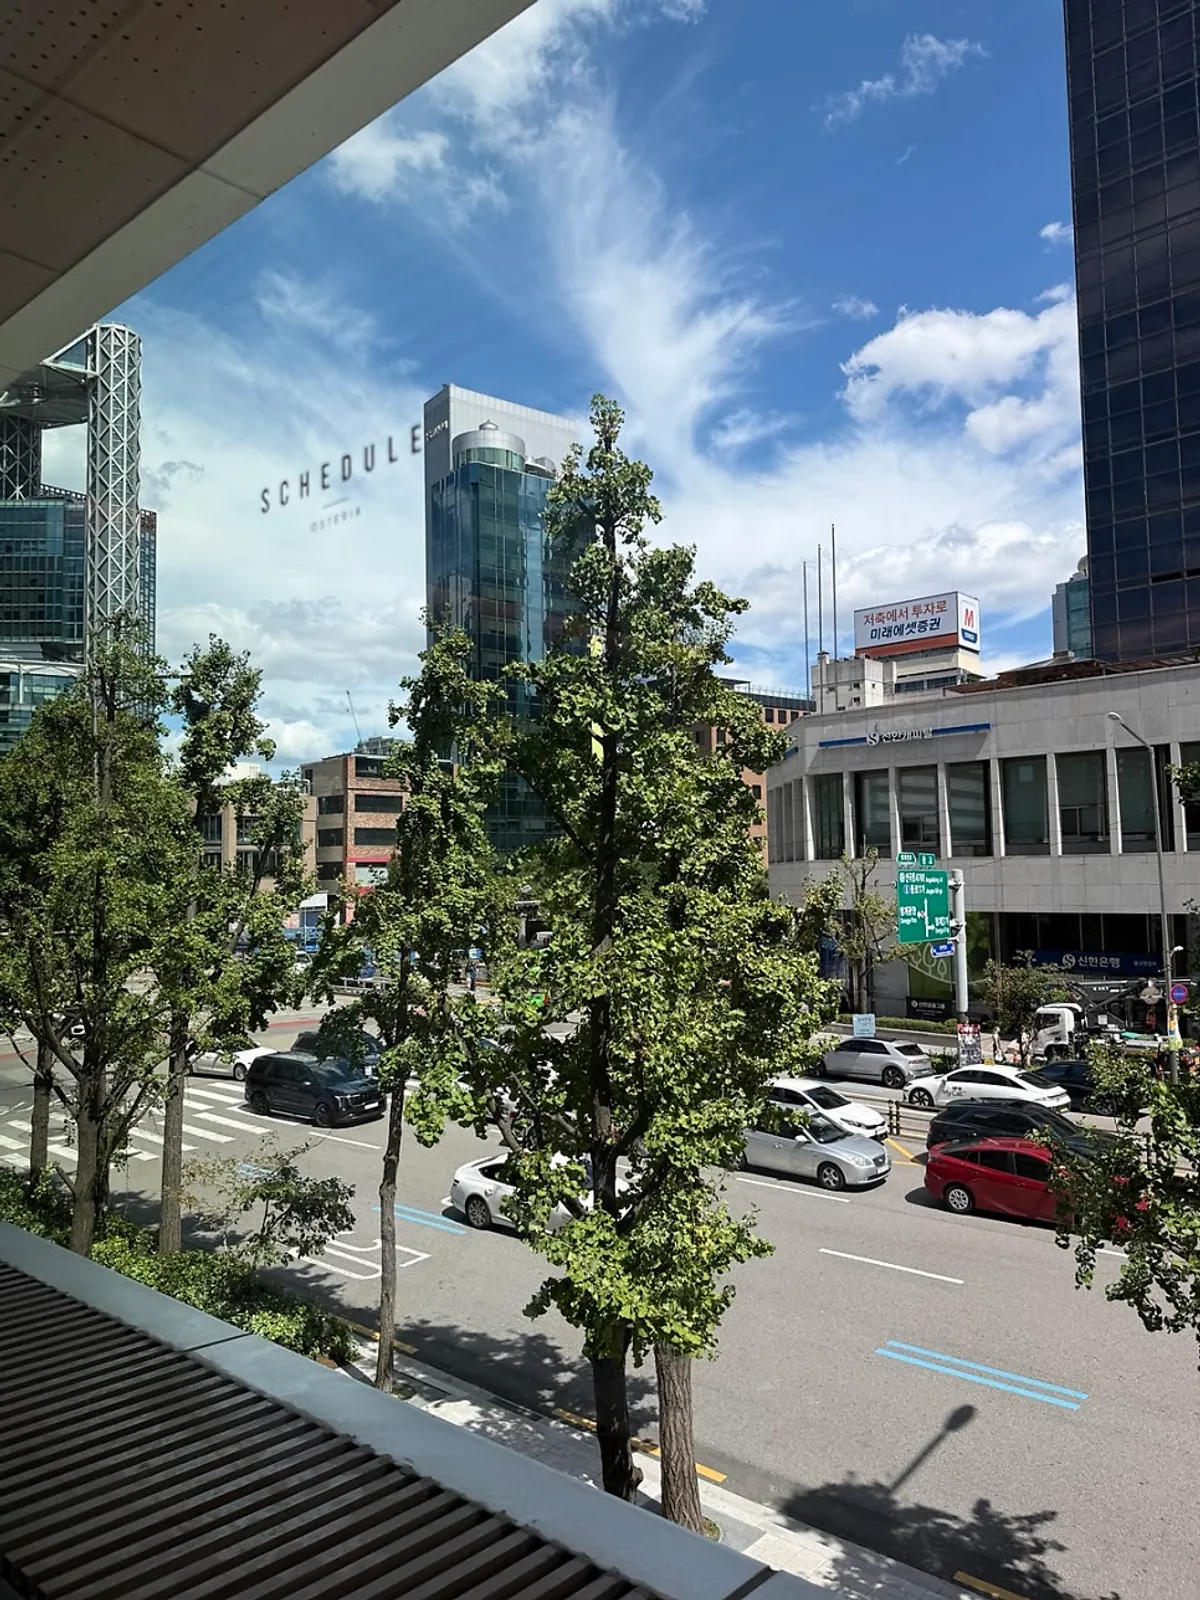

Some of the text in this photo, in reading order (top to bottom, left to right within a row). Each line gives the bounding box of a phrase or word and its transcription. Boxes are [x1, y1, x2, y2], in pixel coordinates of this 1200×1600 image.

[260, 423, 422, 514] SCHEDULE
[863, 600, 948, 626] 저축에서 투자로
[870, 617, 941, 640] 미래에셋증권
[1078, 955, 1120, 969] 신한은행
